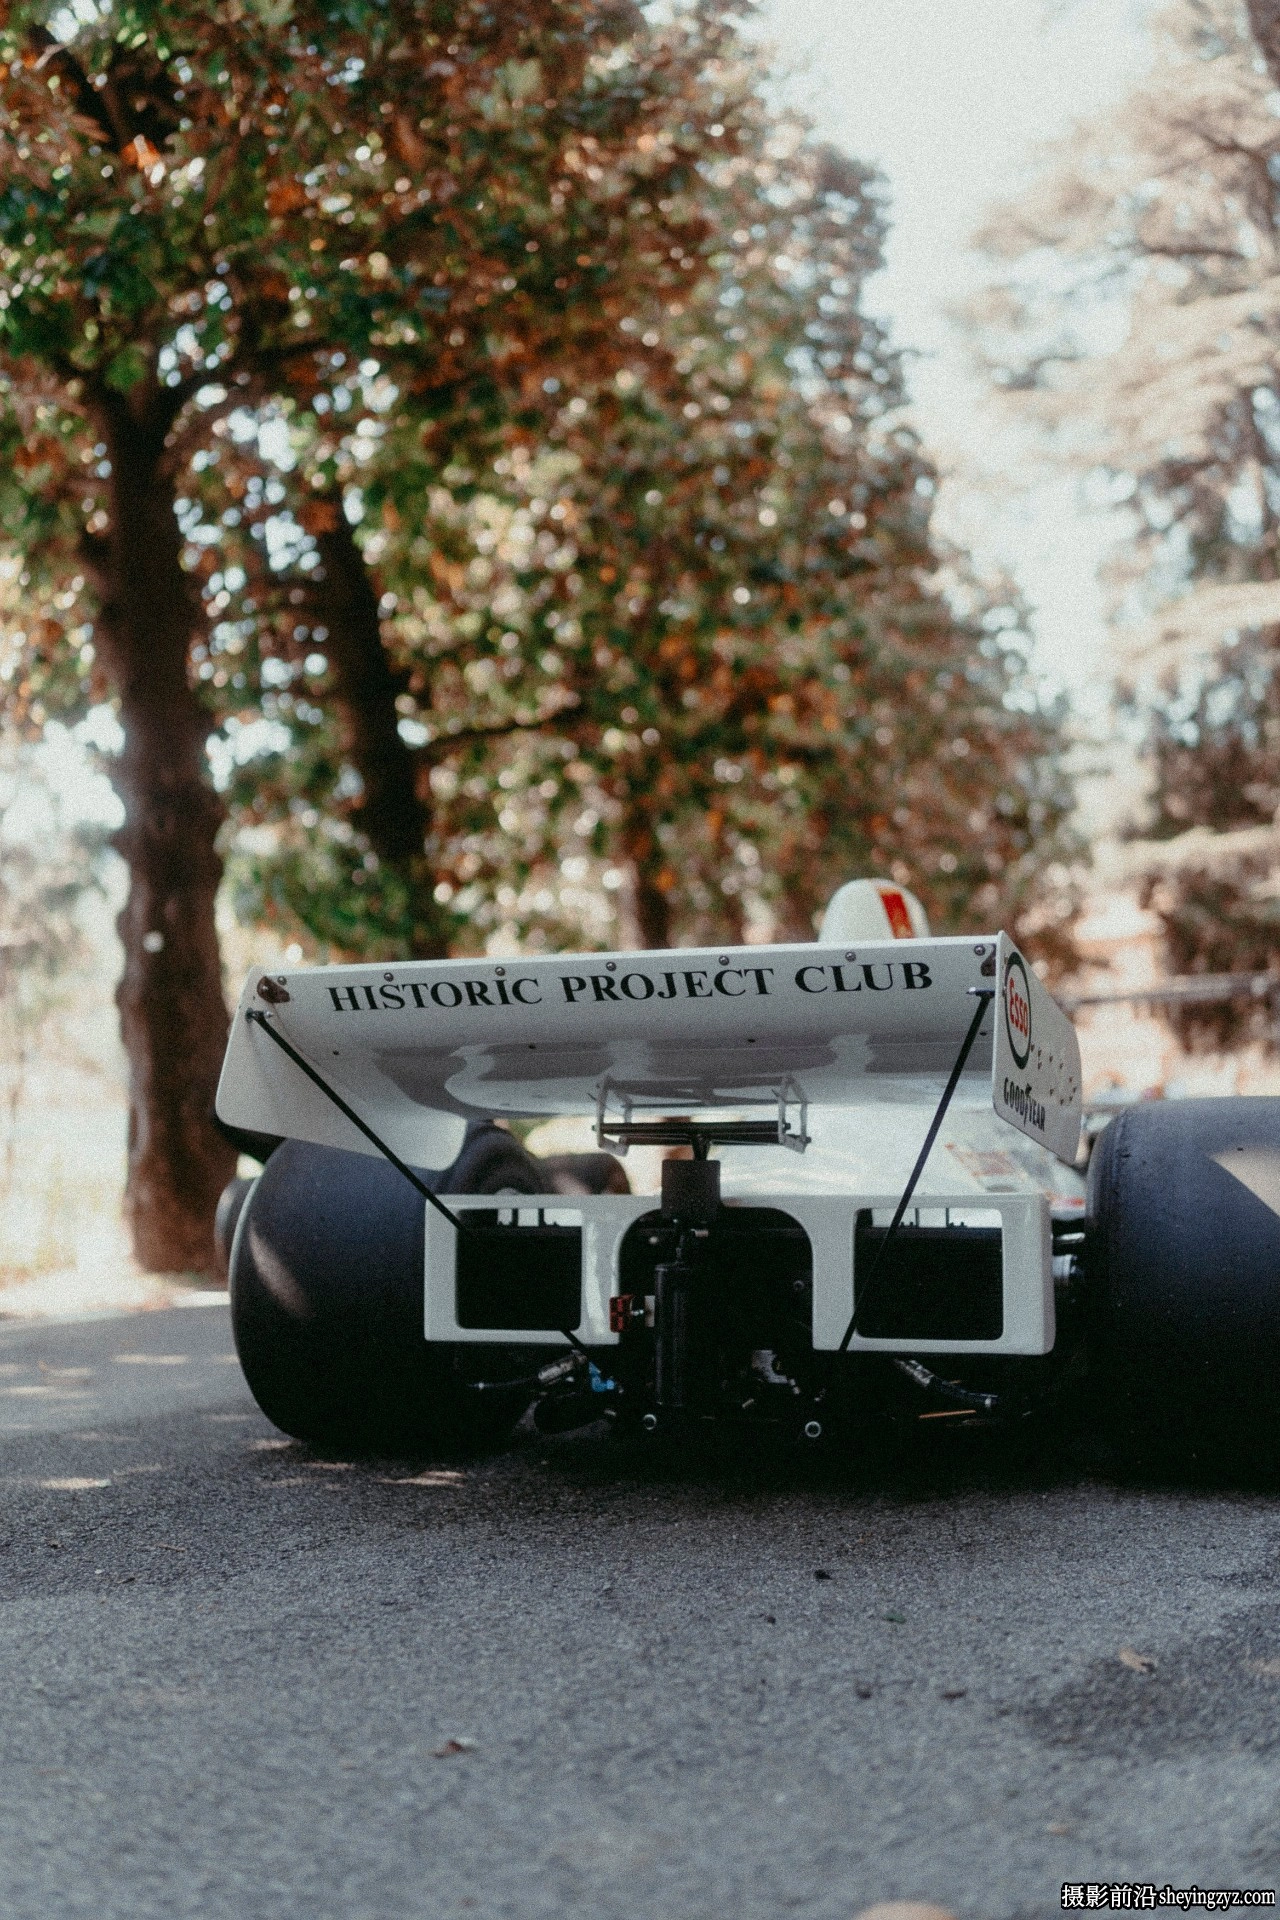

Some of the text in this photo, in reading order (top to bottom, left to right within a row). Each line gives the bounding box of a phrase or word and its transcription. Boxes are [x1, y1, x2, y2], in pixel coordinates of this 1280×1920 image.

[326, 962, 933, 1012] HISTORIC PROJECT CLUB
[1003, 1076, 1046, 1133] GOODYEAR
